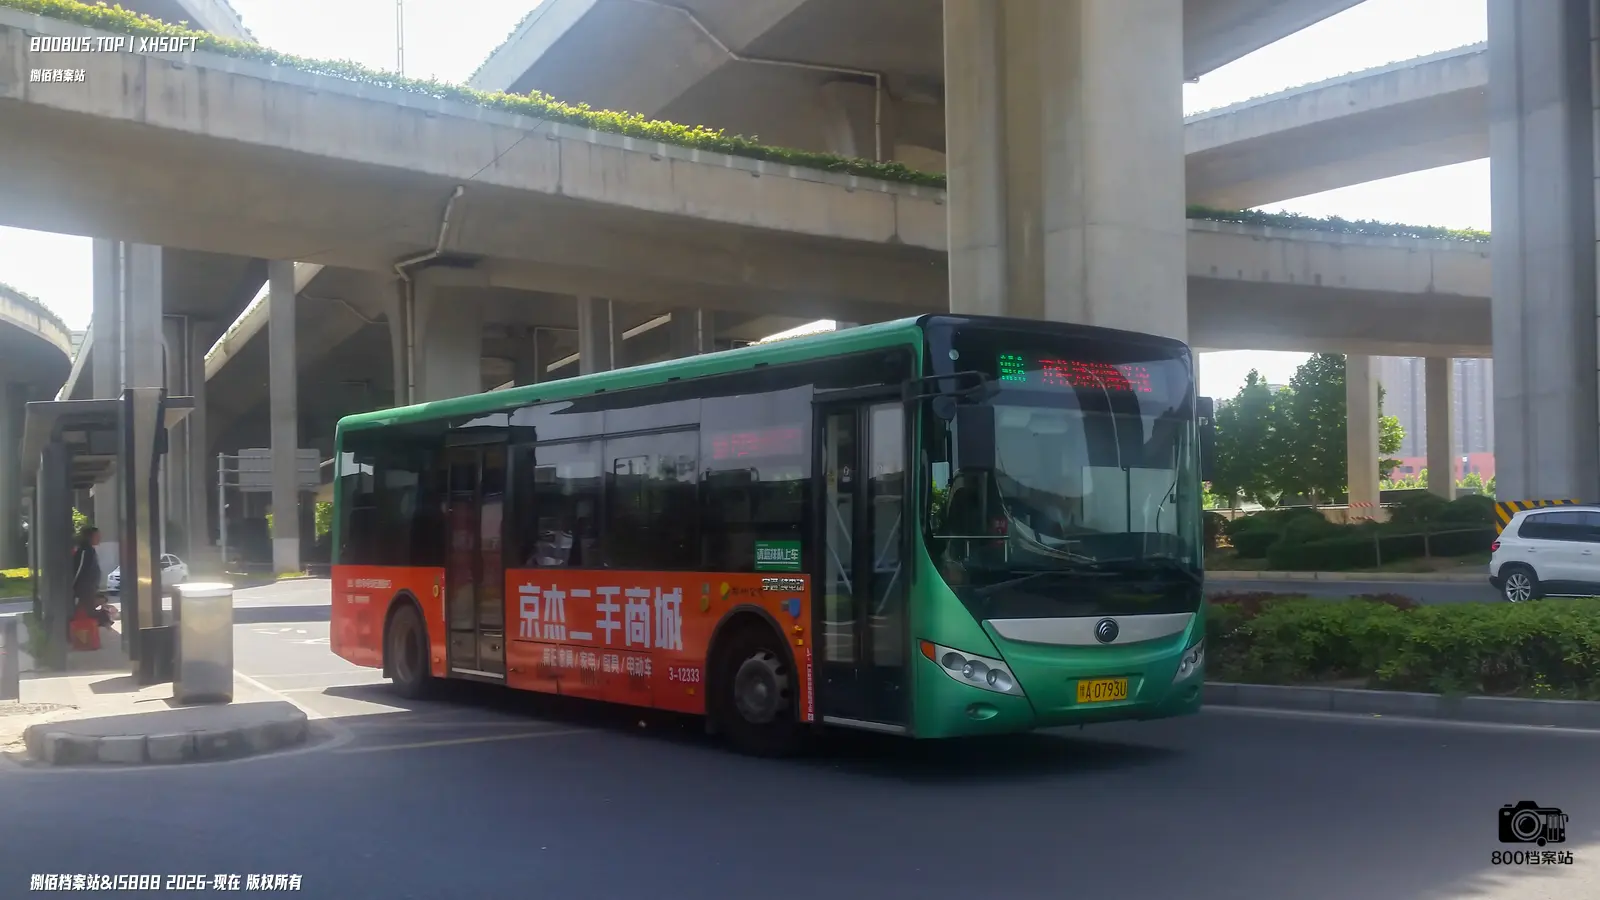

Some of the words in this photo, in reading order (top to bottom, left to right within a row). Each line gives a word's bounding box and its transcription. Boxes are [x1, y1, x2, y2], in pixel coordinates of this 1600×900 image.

[518, 582, 683, 651] 京杰二手商城
[668, 666, 700, 683] 3-12333
